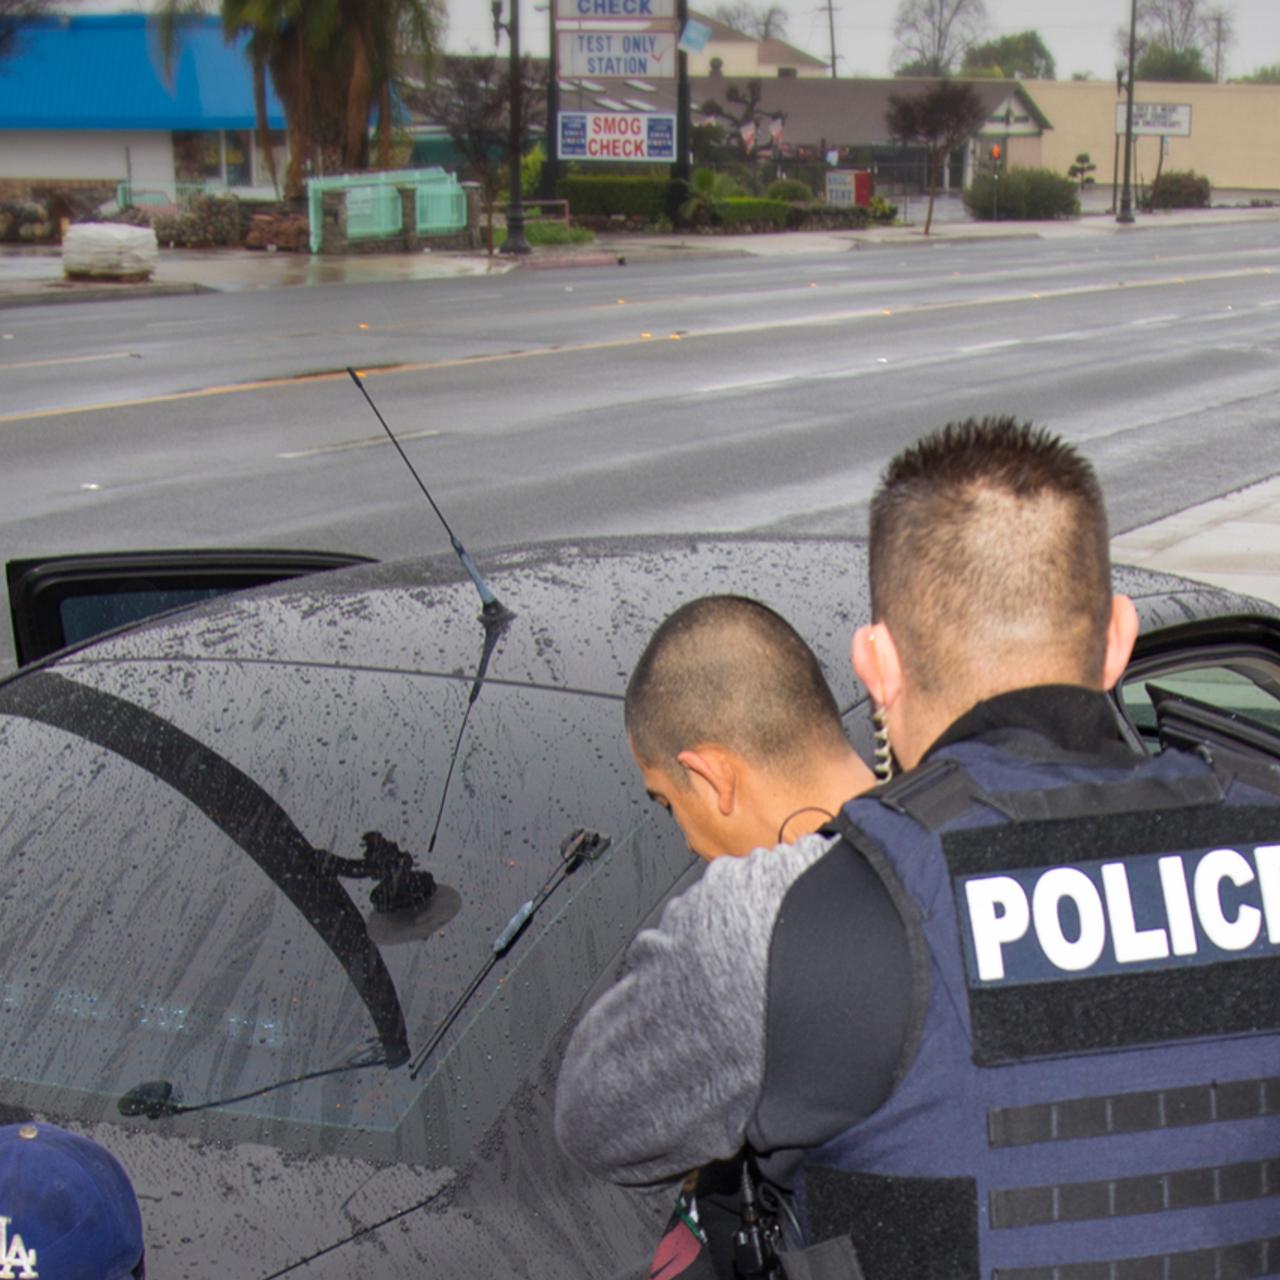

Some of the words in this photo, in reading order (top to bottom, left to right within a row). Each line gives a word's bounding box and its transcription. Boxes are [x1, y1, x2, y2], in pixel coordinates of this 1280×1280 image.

[577, 0, 652, 14] CHECK
[577, 35, 613, 52] TEST
[622, 35, 657, 53] ONLY
[587, 57, 648, 74] STATION
[592, 116, 642, 135] SMOG
[587, 139, 645, 157] CHECK
